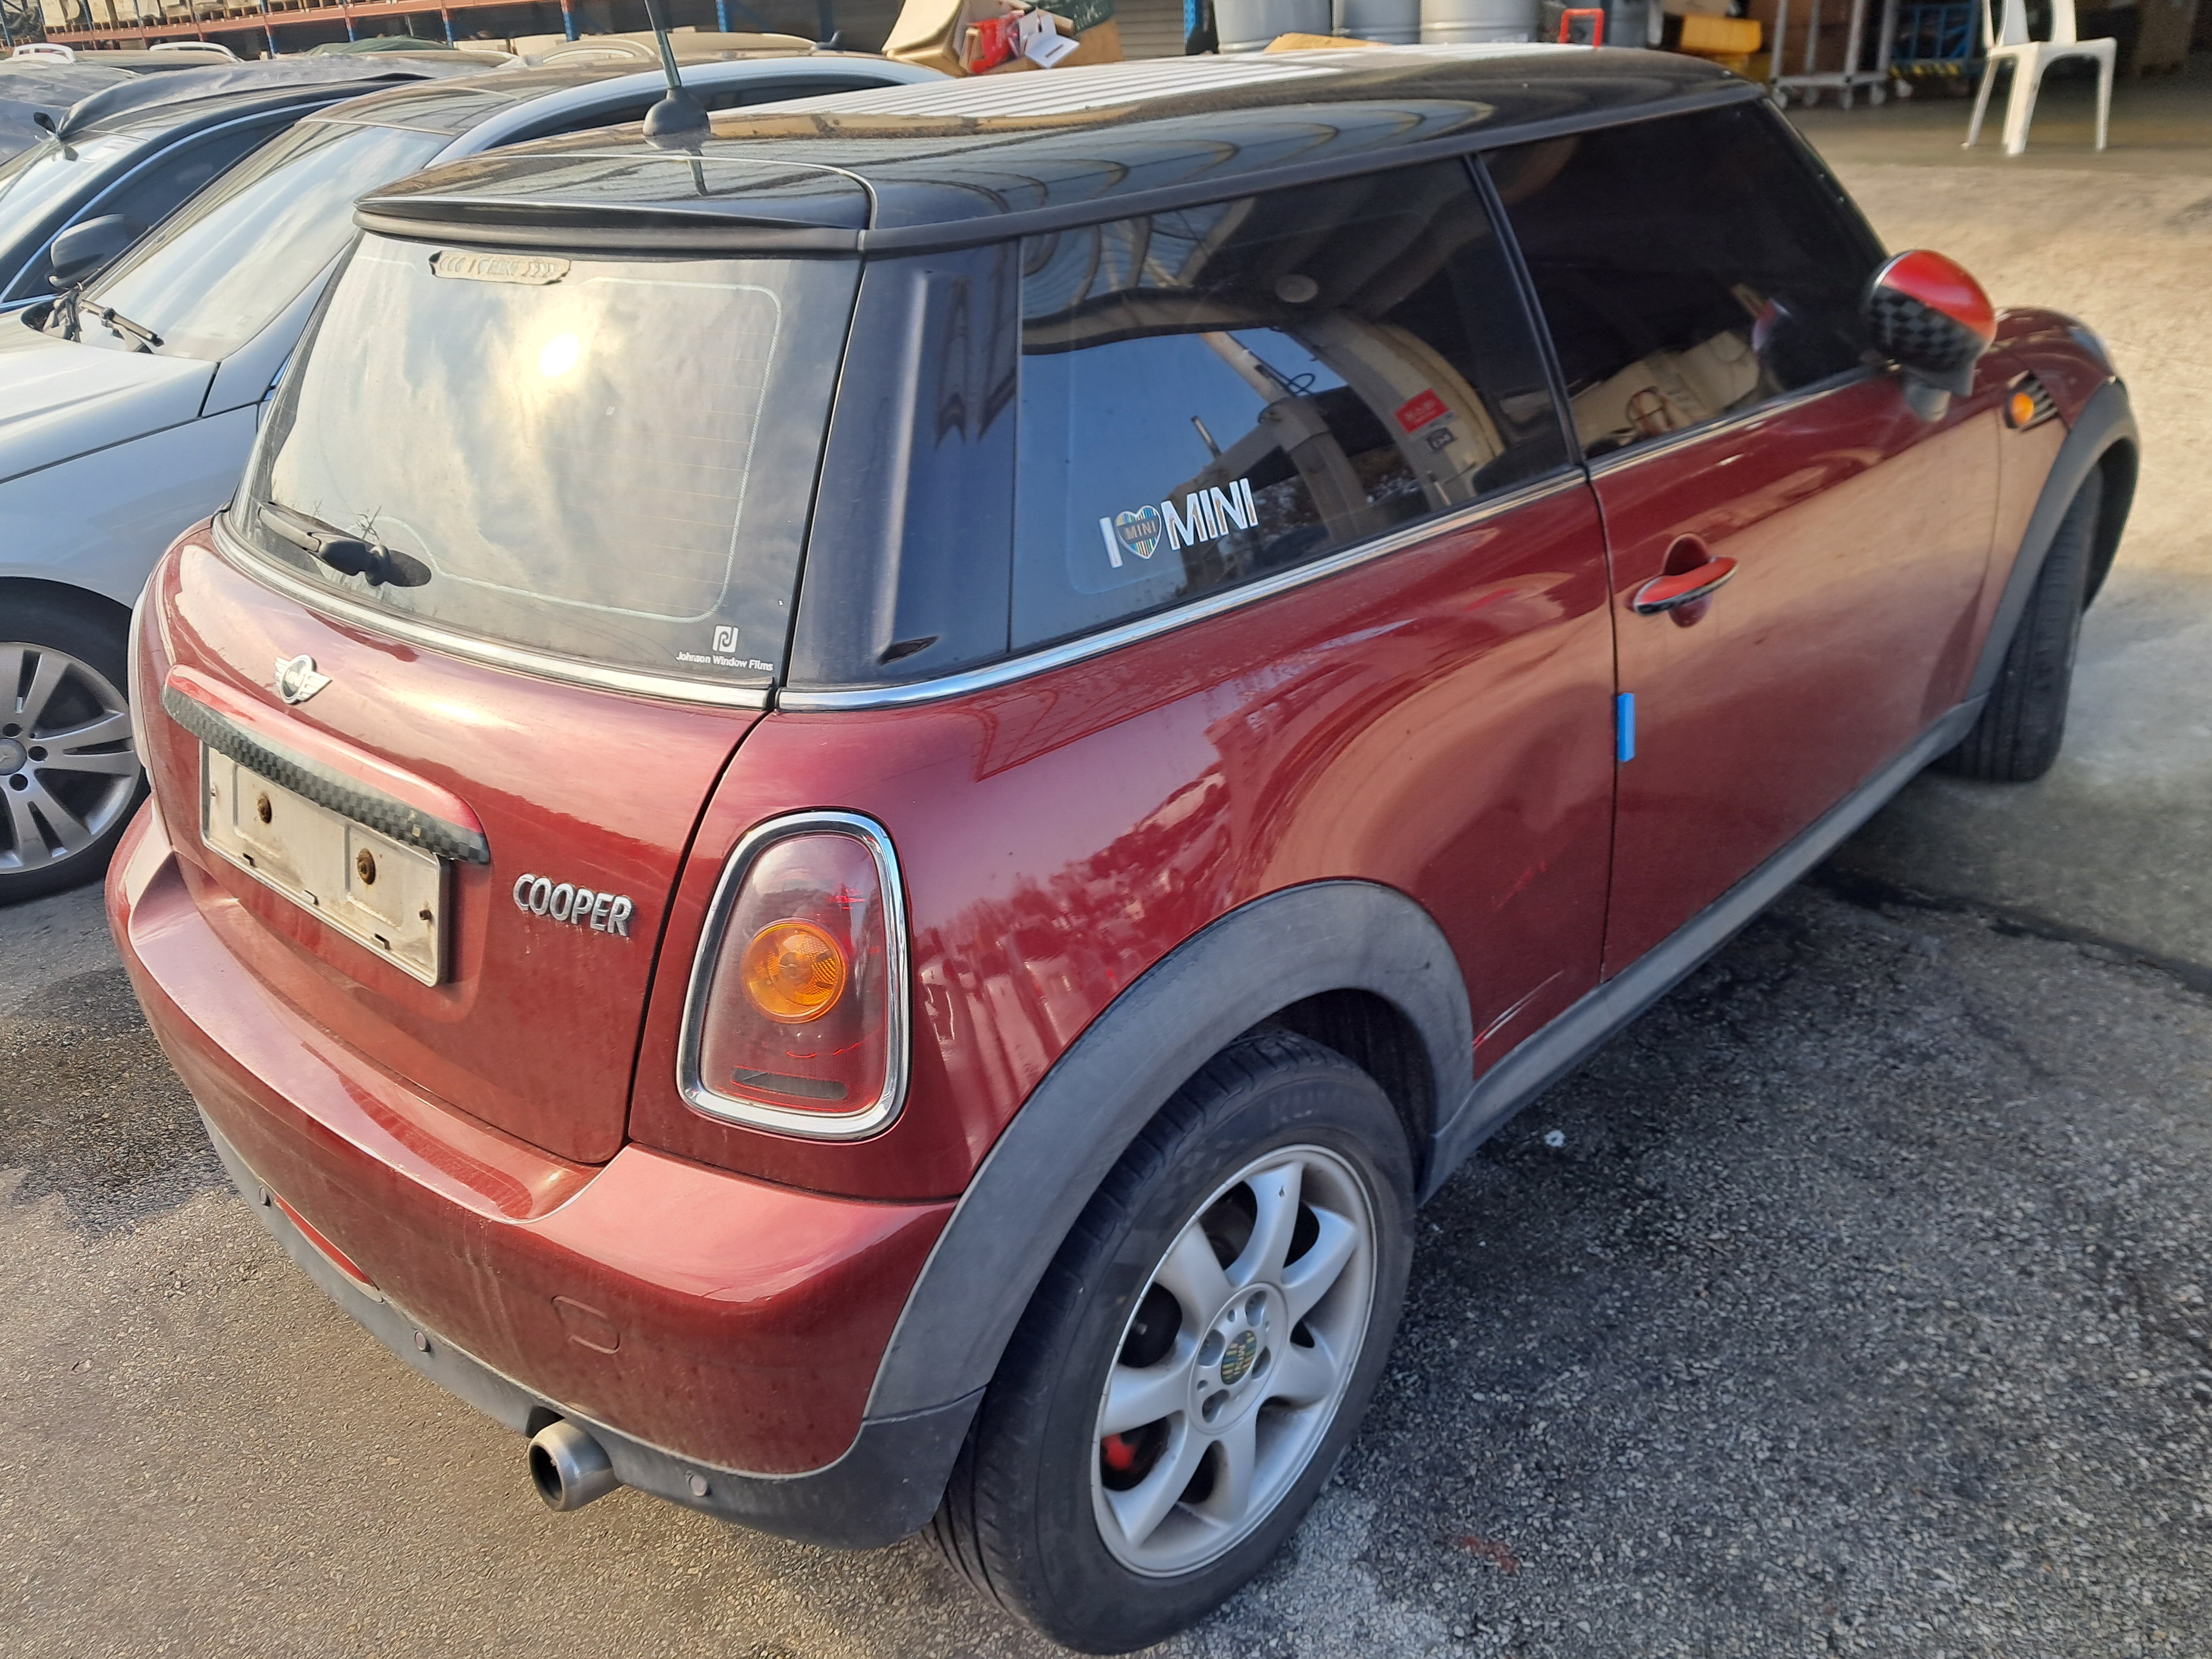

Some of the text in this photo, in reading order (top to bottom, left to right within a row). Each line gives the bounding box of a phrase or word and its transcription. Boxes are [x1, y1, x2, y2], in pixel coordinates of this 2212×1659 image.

[1098, 477, 1259, 568] I MINI
[1124, 520, 1156, 541] MINI
[676, 651, 774, 671] Johnson Window Films
[513, 873, 632, 937] COOPER
